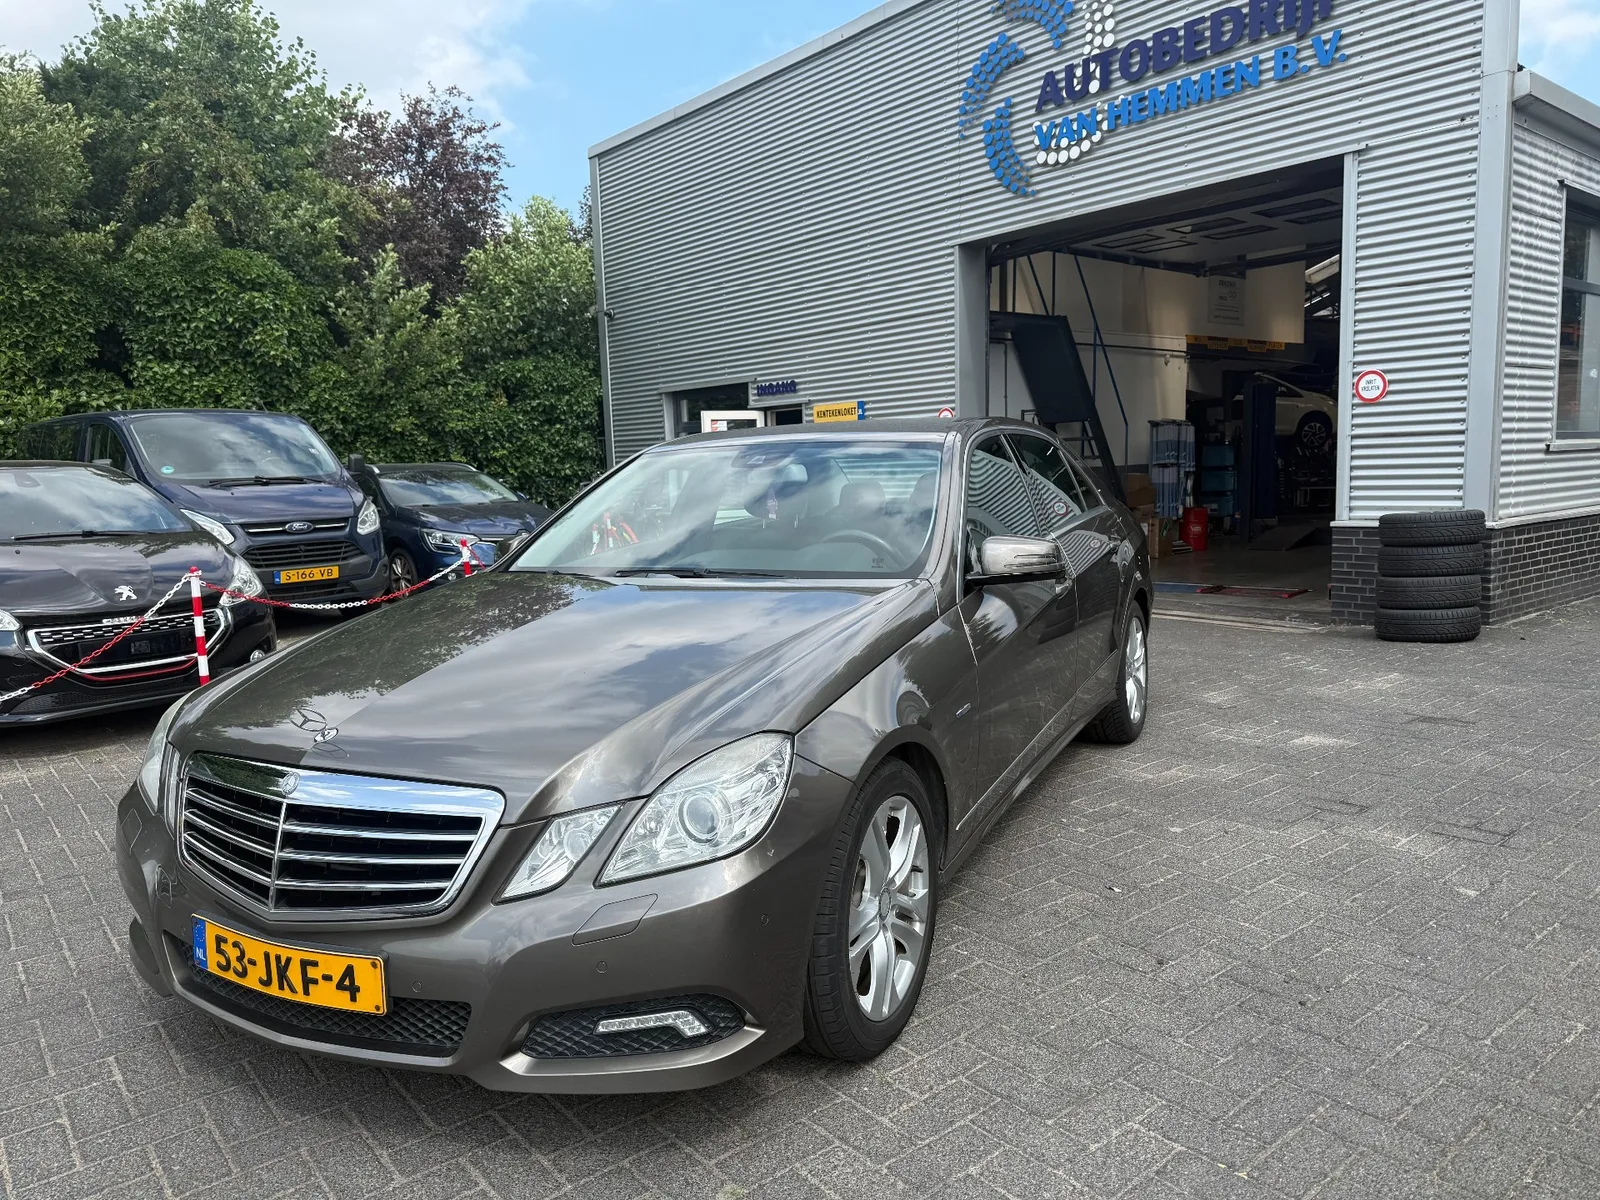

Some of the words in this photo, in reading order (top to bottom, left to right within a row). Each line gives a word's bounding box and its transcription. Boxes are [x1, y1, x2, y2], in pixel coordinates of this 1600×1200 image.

[1034, 107, 1098, 151] VAN
[1107, 55, 1260, 130] HEMMEN
[1273, 29, 1347, 80] B.V.
[756, 380, 797, 397] INGANG
[816, 407, 857, 419] KENTEKENLOKET
[195, 947, 206, 961] NL
[214, 933, 361, 1003] 53-JKF-4
